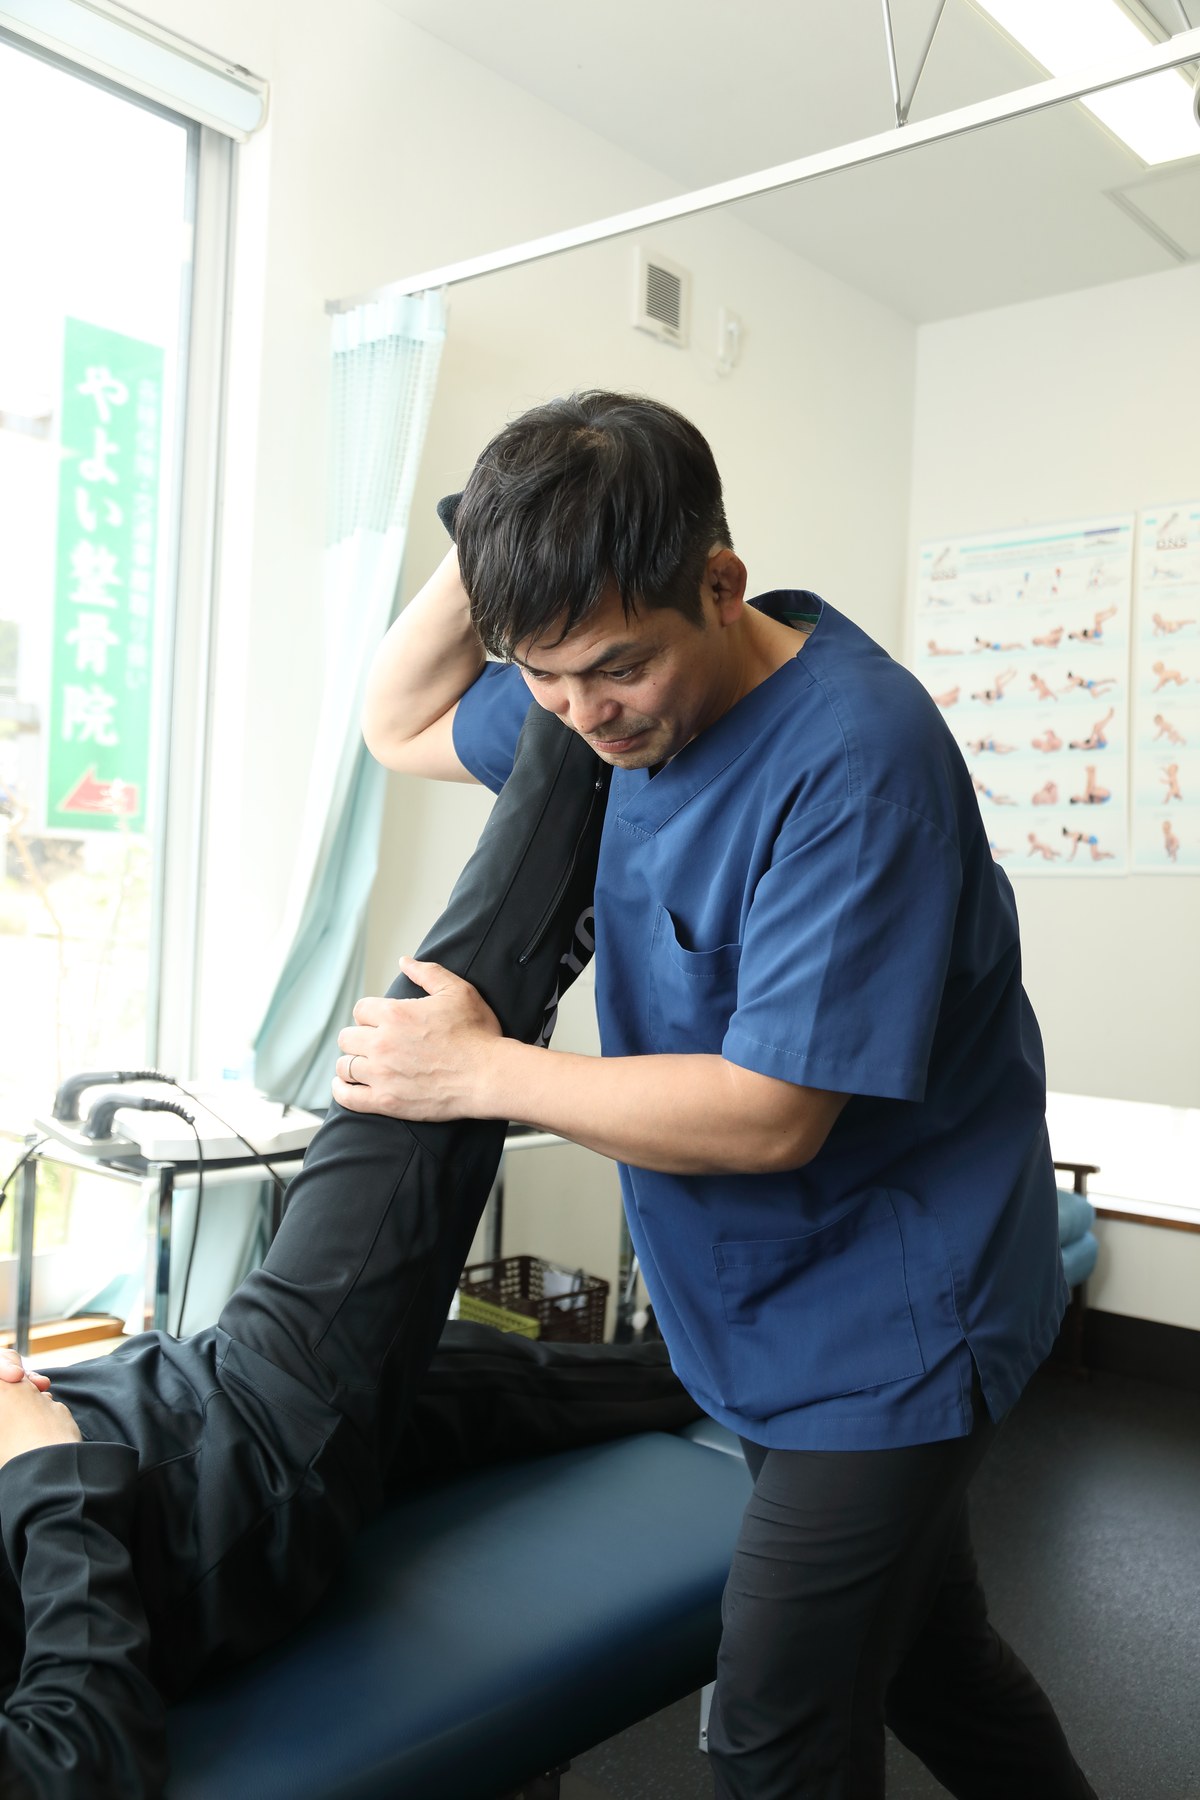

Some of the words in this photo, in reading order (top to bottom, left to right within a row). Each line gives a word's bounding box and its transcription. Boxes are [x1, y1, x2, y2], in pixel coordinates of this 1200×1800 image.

[62, 366, 130, 746] やよい整骨院
